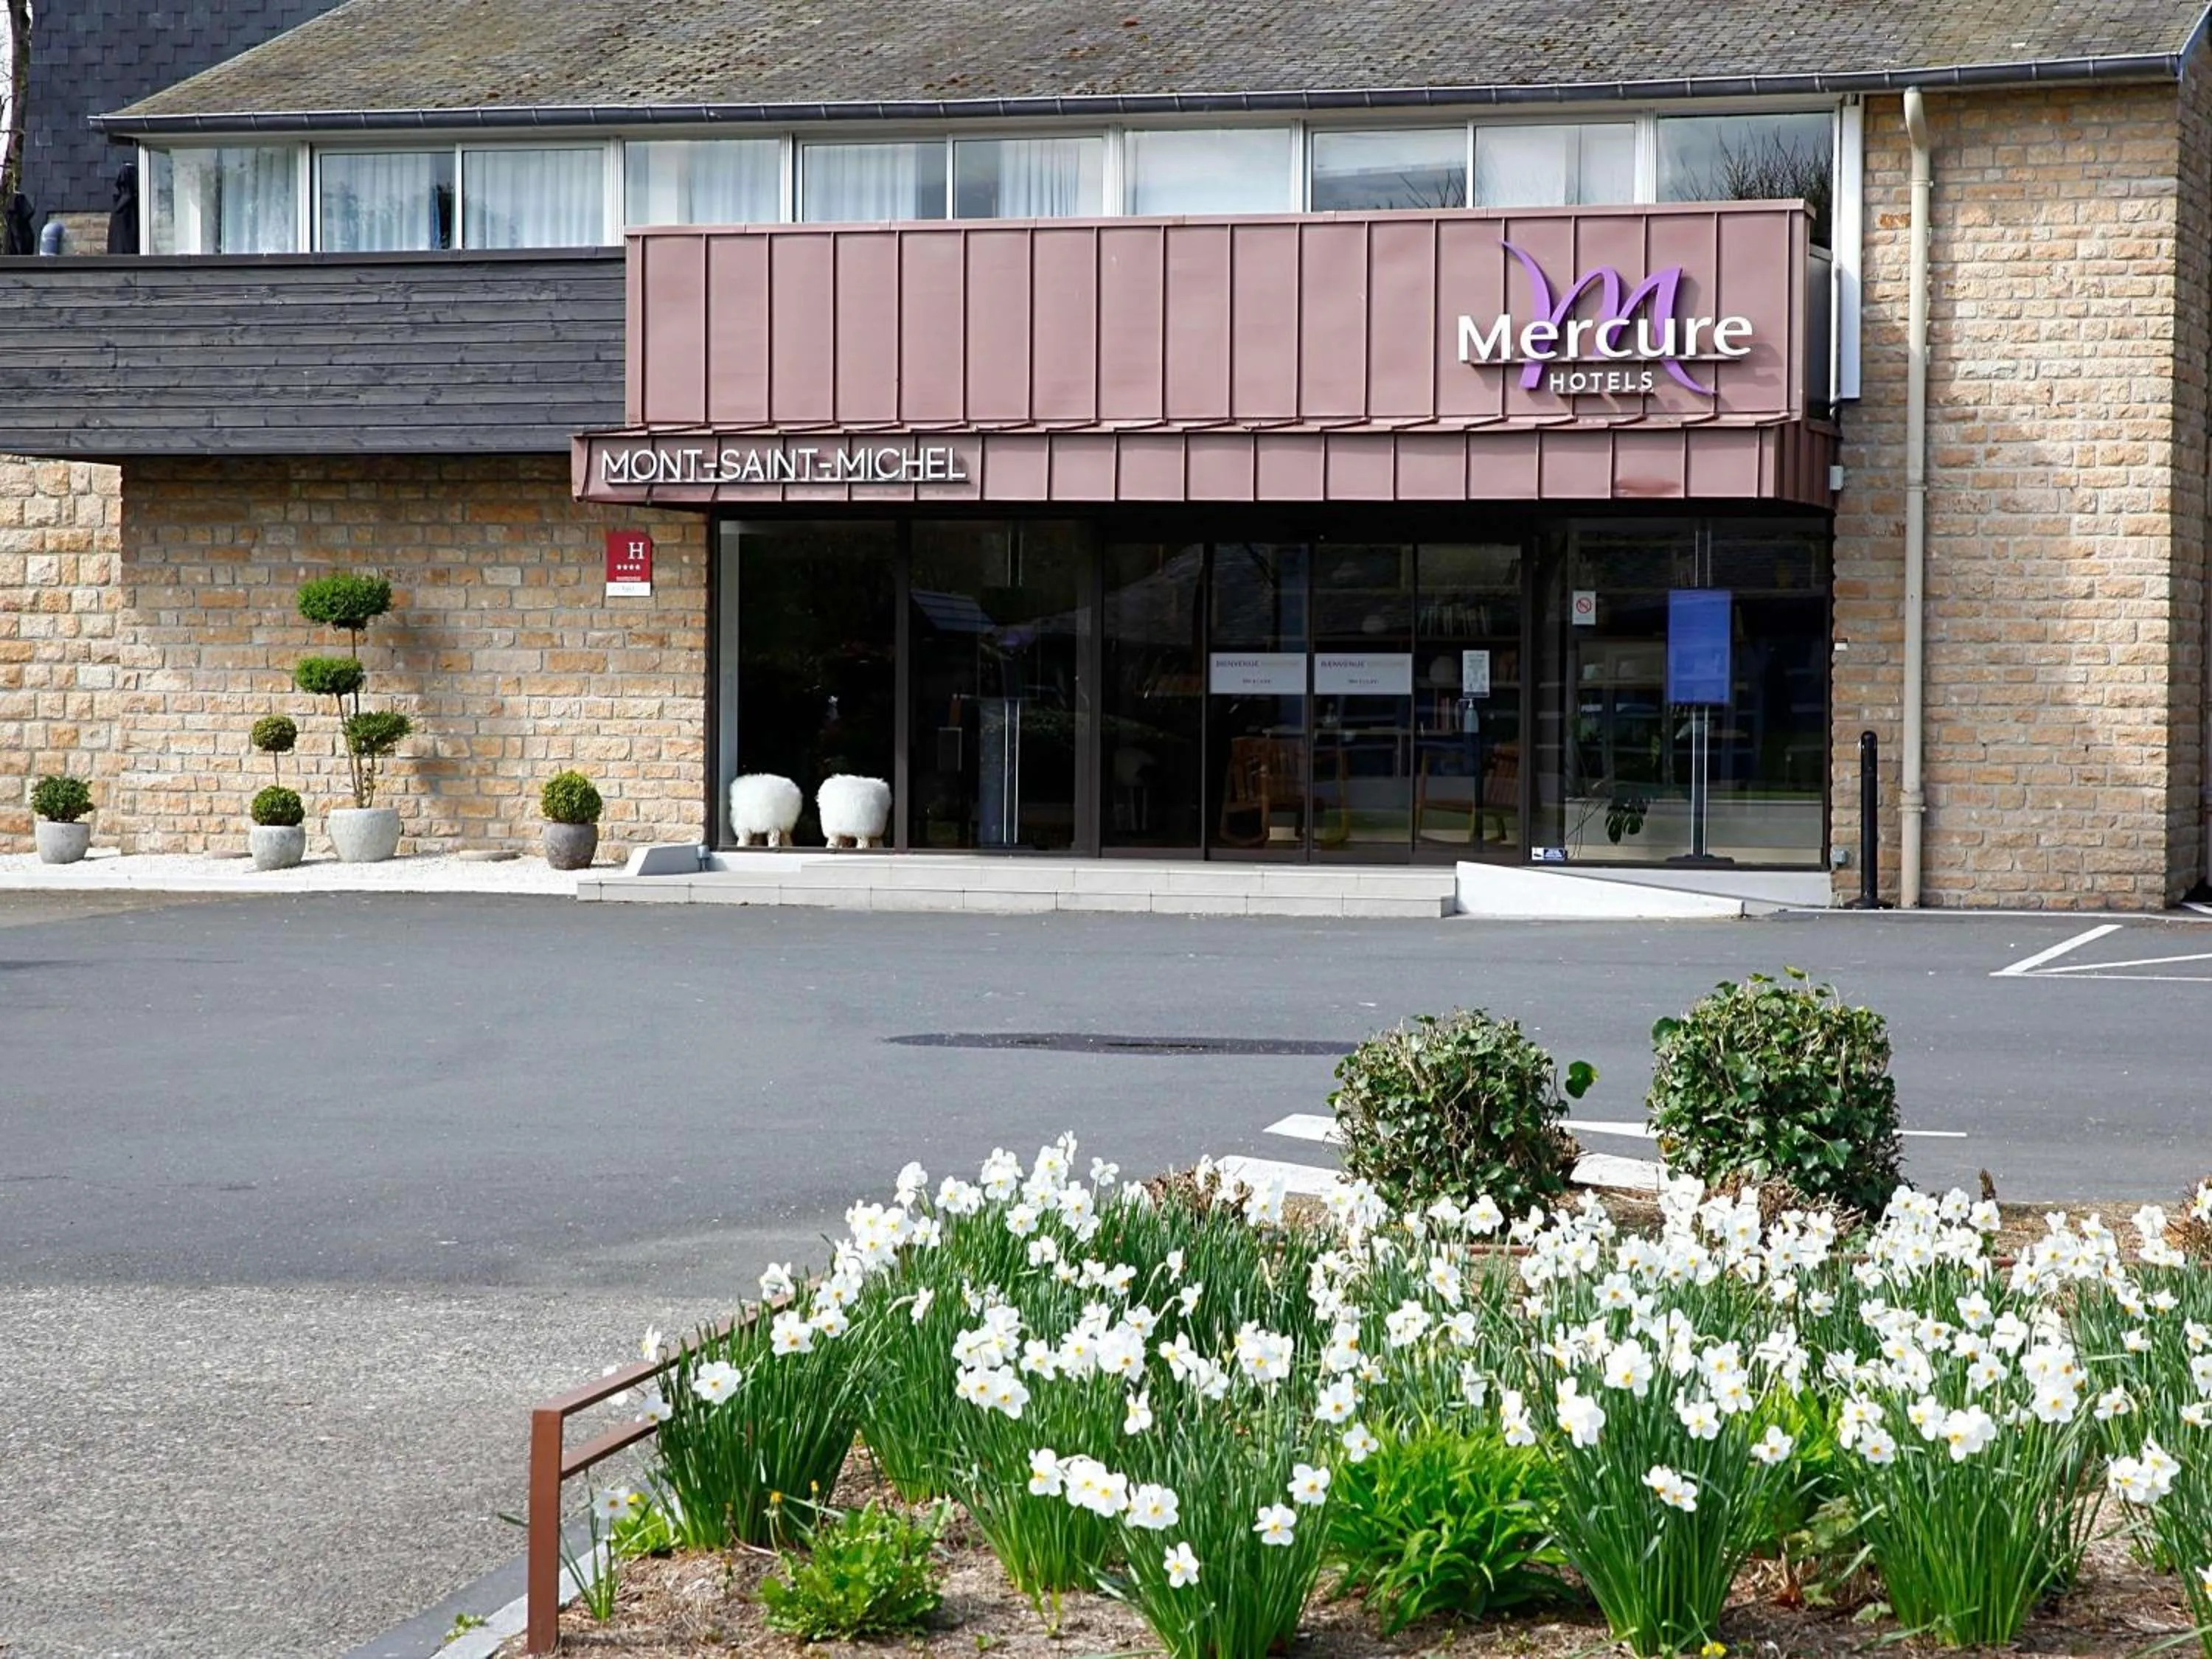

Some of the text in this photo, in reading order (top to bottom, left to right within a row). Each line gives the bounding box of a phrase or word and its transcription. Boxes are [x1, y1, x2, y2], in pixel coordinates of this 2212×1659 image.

[1458, 313, 1753, 362] Mercure
[1550, 371, 1653, 392] HOTELS
[601, 448, 967, 481] MONT-SAINT-MICHEL
[628, 542, 645, 560] H
